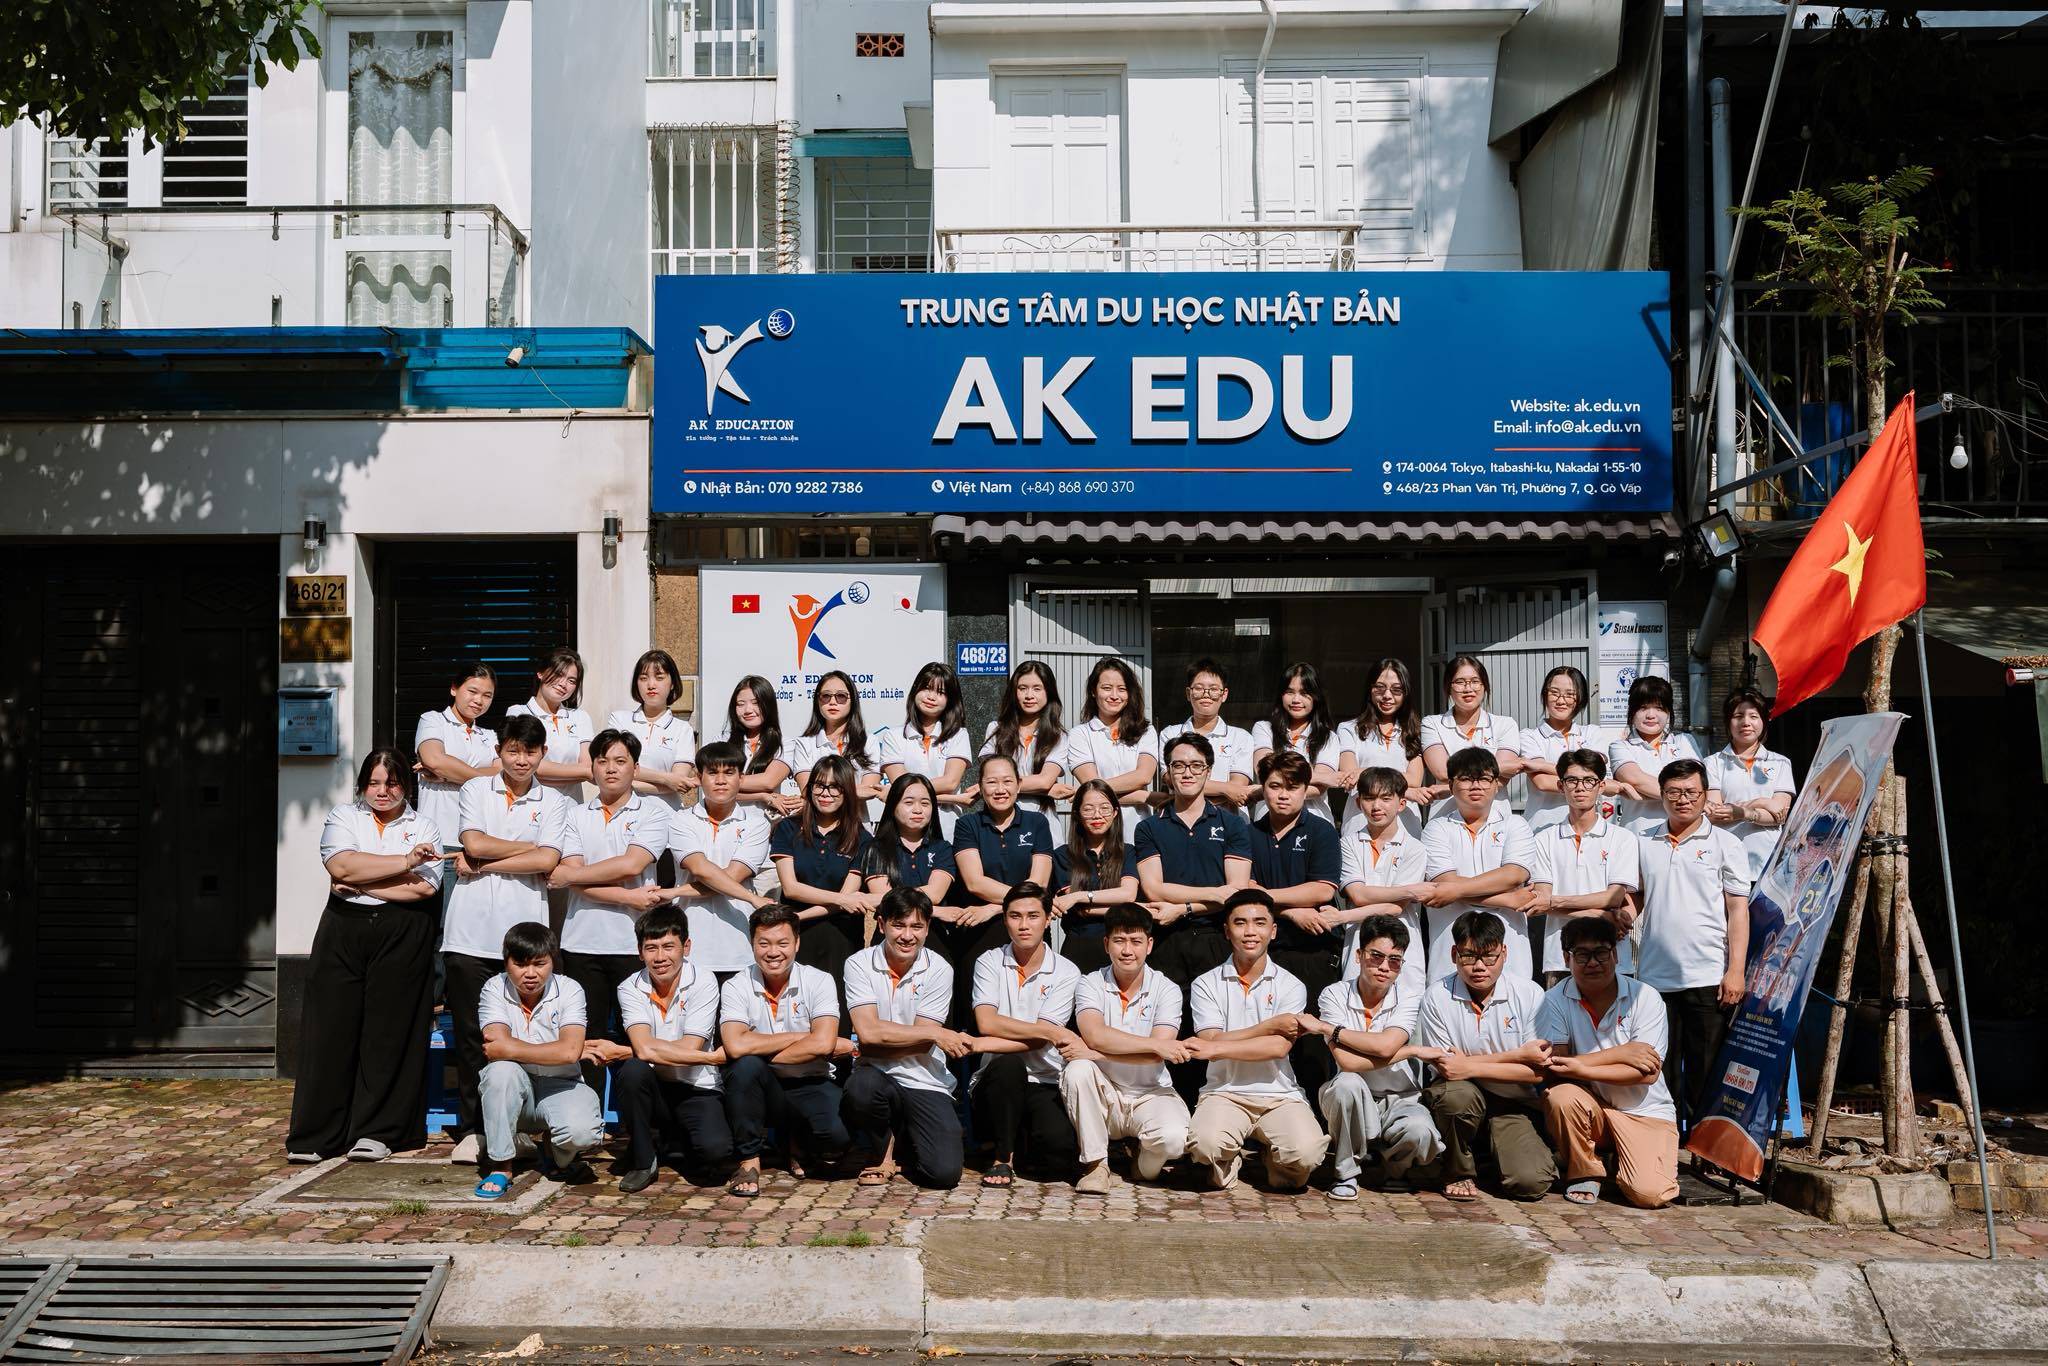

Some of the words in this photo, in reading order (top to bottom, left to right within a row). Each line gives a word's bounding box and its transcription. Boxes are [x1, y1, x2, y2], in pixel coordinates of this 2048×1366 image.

[901, 298, 1010, 324] TRUNG
[1019, 292, 1088, 323] TÂM
[1098, 298, 1142, 323] DU
[1153, 297, 1225, 330] HỌC
[1235, 291, 1324, 330] NHẬT
[1334, 288, 1401, 322] BẢN
[932, 356, 1098, 440] AK
[1132, 355, 1354, 440] EDU
[1511, 398, 1570, 413] Website:
[1574, 399, 1641, 413] ak.edu.vn
[688, 419, 708, 431] AK
[715, 419, 795, 431] EDUCATION
[1494, 419, 1533, 434] Email:
[1536, 418, 1641, 434] info@ak.edu.vn
[1395, 462, 1448, 473] 174-0064
[1450, 461, 1487, 475] Tokyo,
[1490, 461, 1553, 475] Itabashi-ku,
[1555, 462, 1600, 473] Nakadai
[1603, 462, 1642, 473] 1-55-10
[700, 481, 732, 497] Nhật
[735, 480, 765, 494] Bản:
[768, 481, 792, 494] 070
[795, 481, 828, 494] 9282
[831, 481, 864, 494] 7386
[948, 480, 977, 497] Việt
[980, 481, 1012, 493] Nam
[1021, 481, 1055, 496] (+84)
[1058, 481, 1082, 493] 868
[1084, 481, 1108, 493] 690
[1111, 481, 1135, 493] 370
[1396, 482, 1439, 495] 468/23
[1442, 482, 1472, 493] Phan
[1475, 481, 1498, 493] Văn
[1501, 482, 1519, 496] Trị,
[1521, 482, 1567, 495] Phường
[1570, 482, 1580, 495] 7,
[1583, 483, 1598, 495] Q.
[1600, 483, 1617, 493] Gò
[1620, 482, 1642, 495] Vấp
[290, 583, 344, 600] 468/21
[960, 646, 1007, 664] 468/23
[782, 675, 797, 684] AK
[805, 674, 873, 684] EDION
[880, 687, 905, 701] nhiệm
